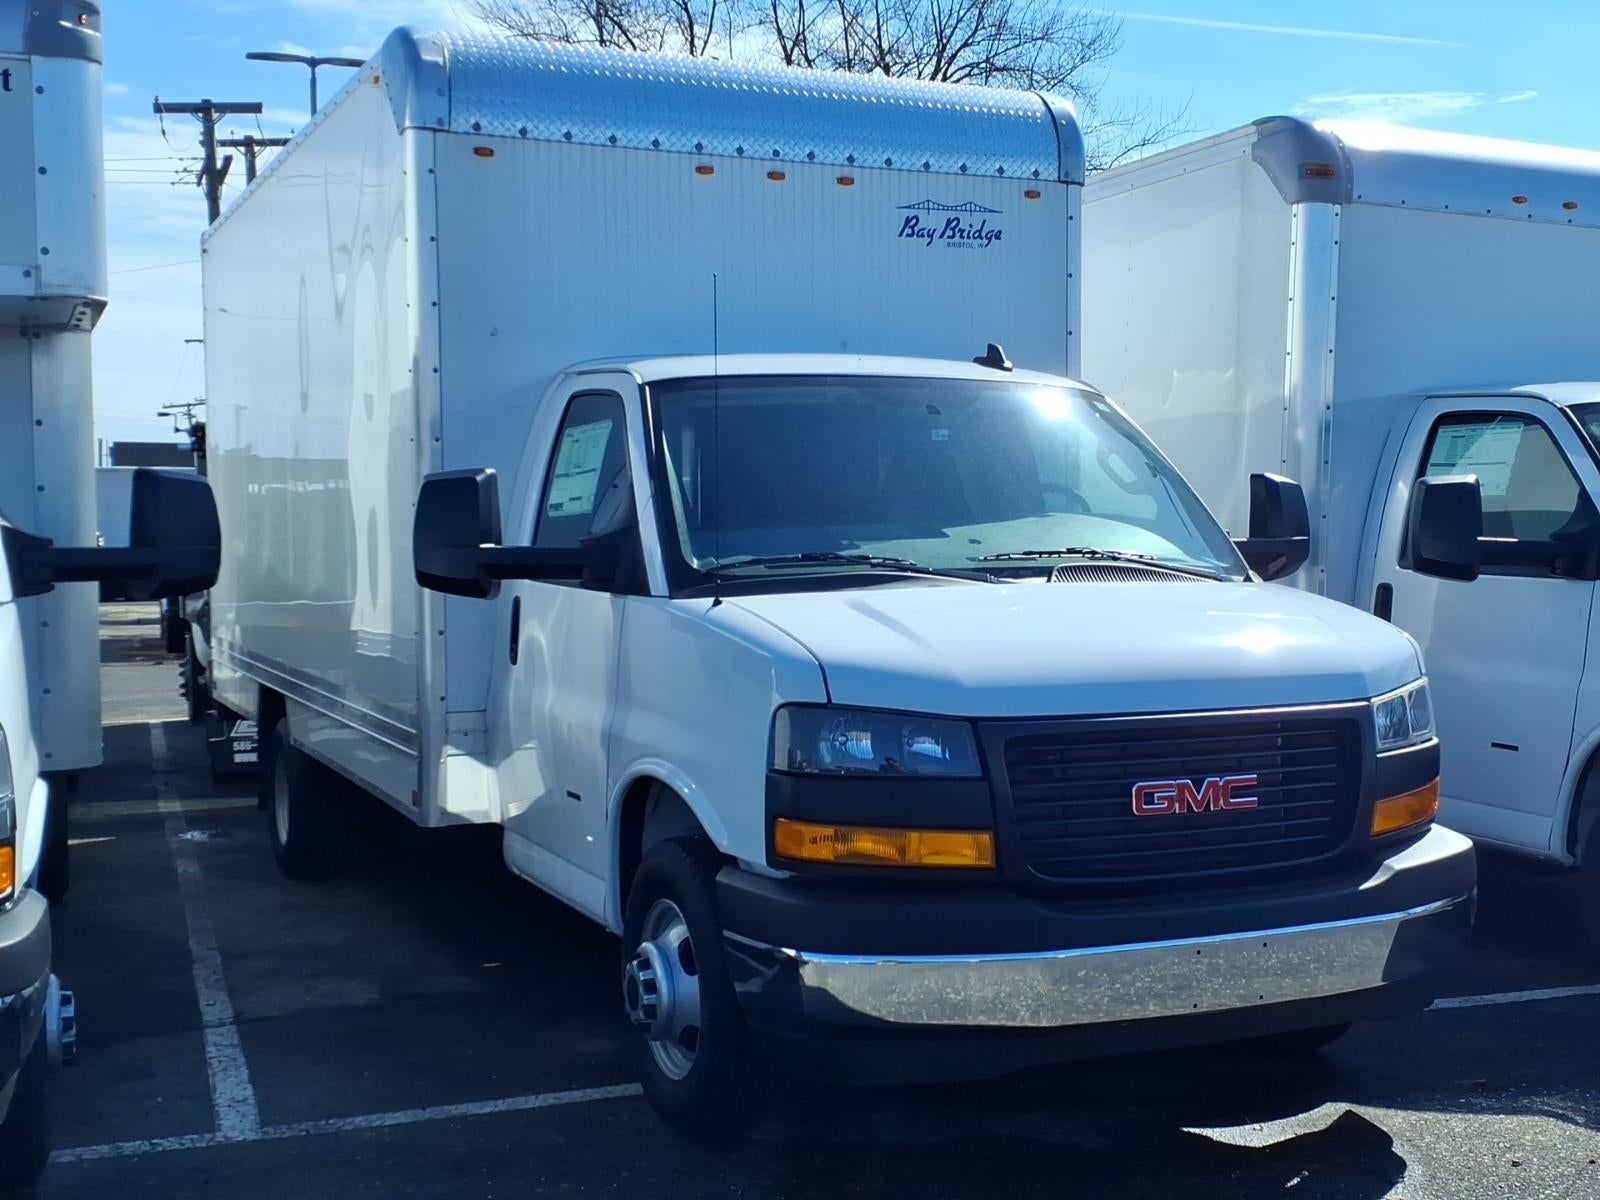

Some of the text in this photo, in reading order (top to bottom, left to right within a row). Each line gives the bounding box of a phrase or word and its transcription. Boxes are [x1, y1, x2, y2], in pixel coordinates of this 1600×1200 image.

[898, 215, 1002, 248] Bay Bridge
[946, 241, 976, 249] BRISTOL,
[1132, 774, 1258, 815] GMC
